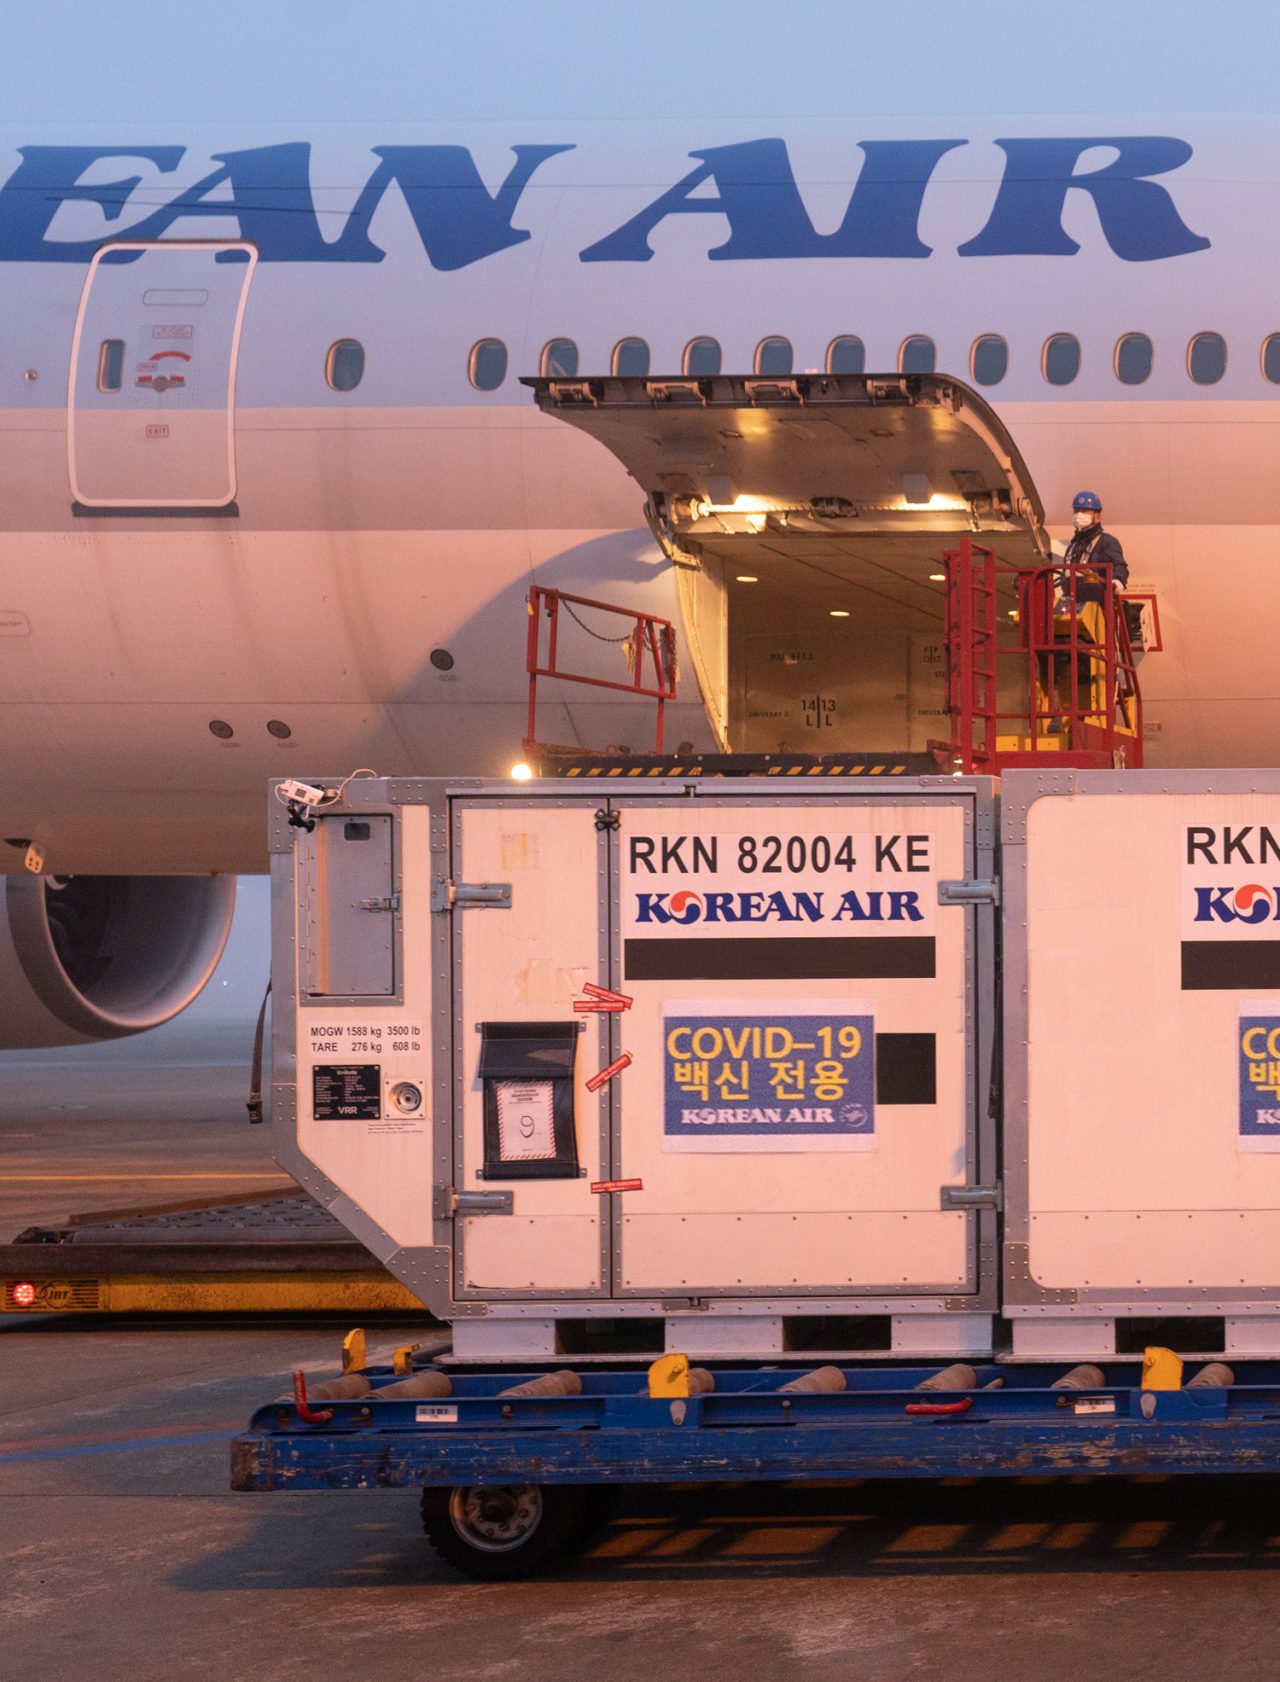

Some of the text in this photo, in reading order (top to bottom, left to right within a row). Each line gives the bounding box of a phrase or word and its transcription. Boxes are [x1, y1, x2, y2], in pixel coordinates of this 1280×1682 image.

[580, 136, 1211, 262] AIR
[801, 699, 836, 711] 14 13
[806, 714, 832, 726] L L
[630, 835, 930, 873] RKN 82004 KE
[635, 890, 925, 925] KOREAN AIR
[311, 1026, 420, 1038] MOGW 1588 kg 3500 lb
[311, 1042, 420, 1053] TARE 276 kg 608 lb
[666, 1026, 862, 1060] COVID-19
[673, 1060, 849, 1101] 백신 전용
[337, 1106, 358, 1114] VRR
[681, 1107, 782, 1125] KOREAN
[785, 1107, 835, 1123] AIR
[520, 1115, 535, 1138] 9
